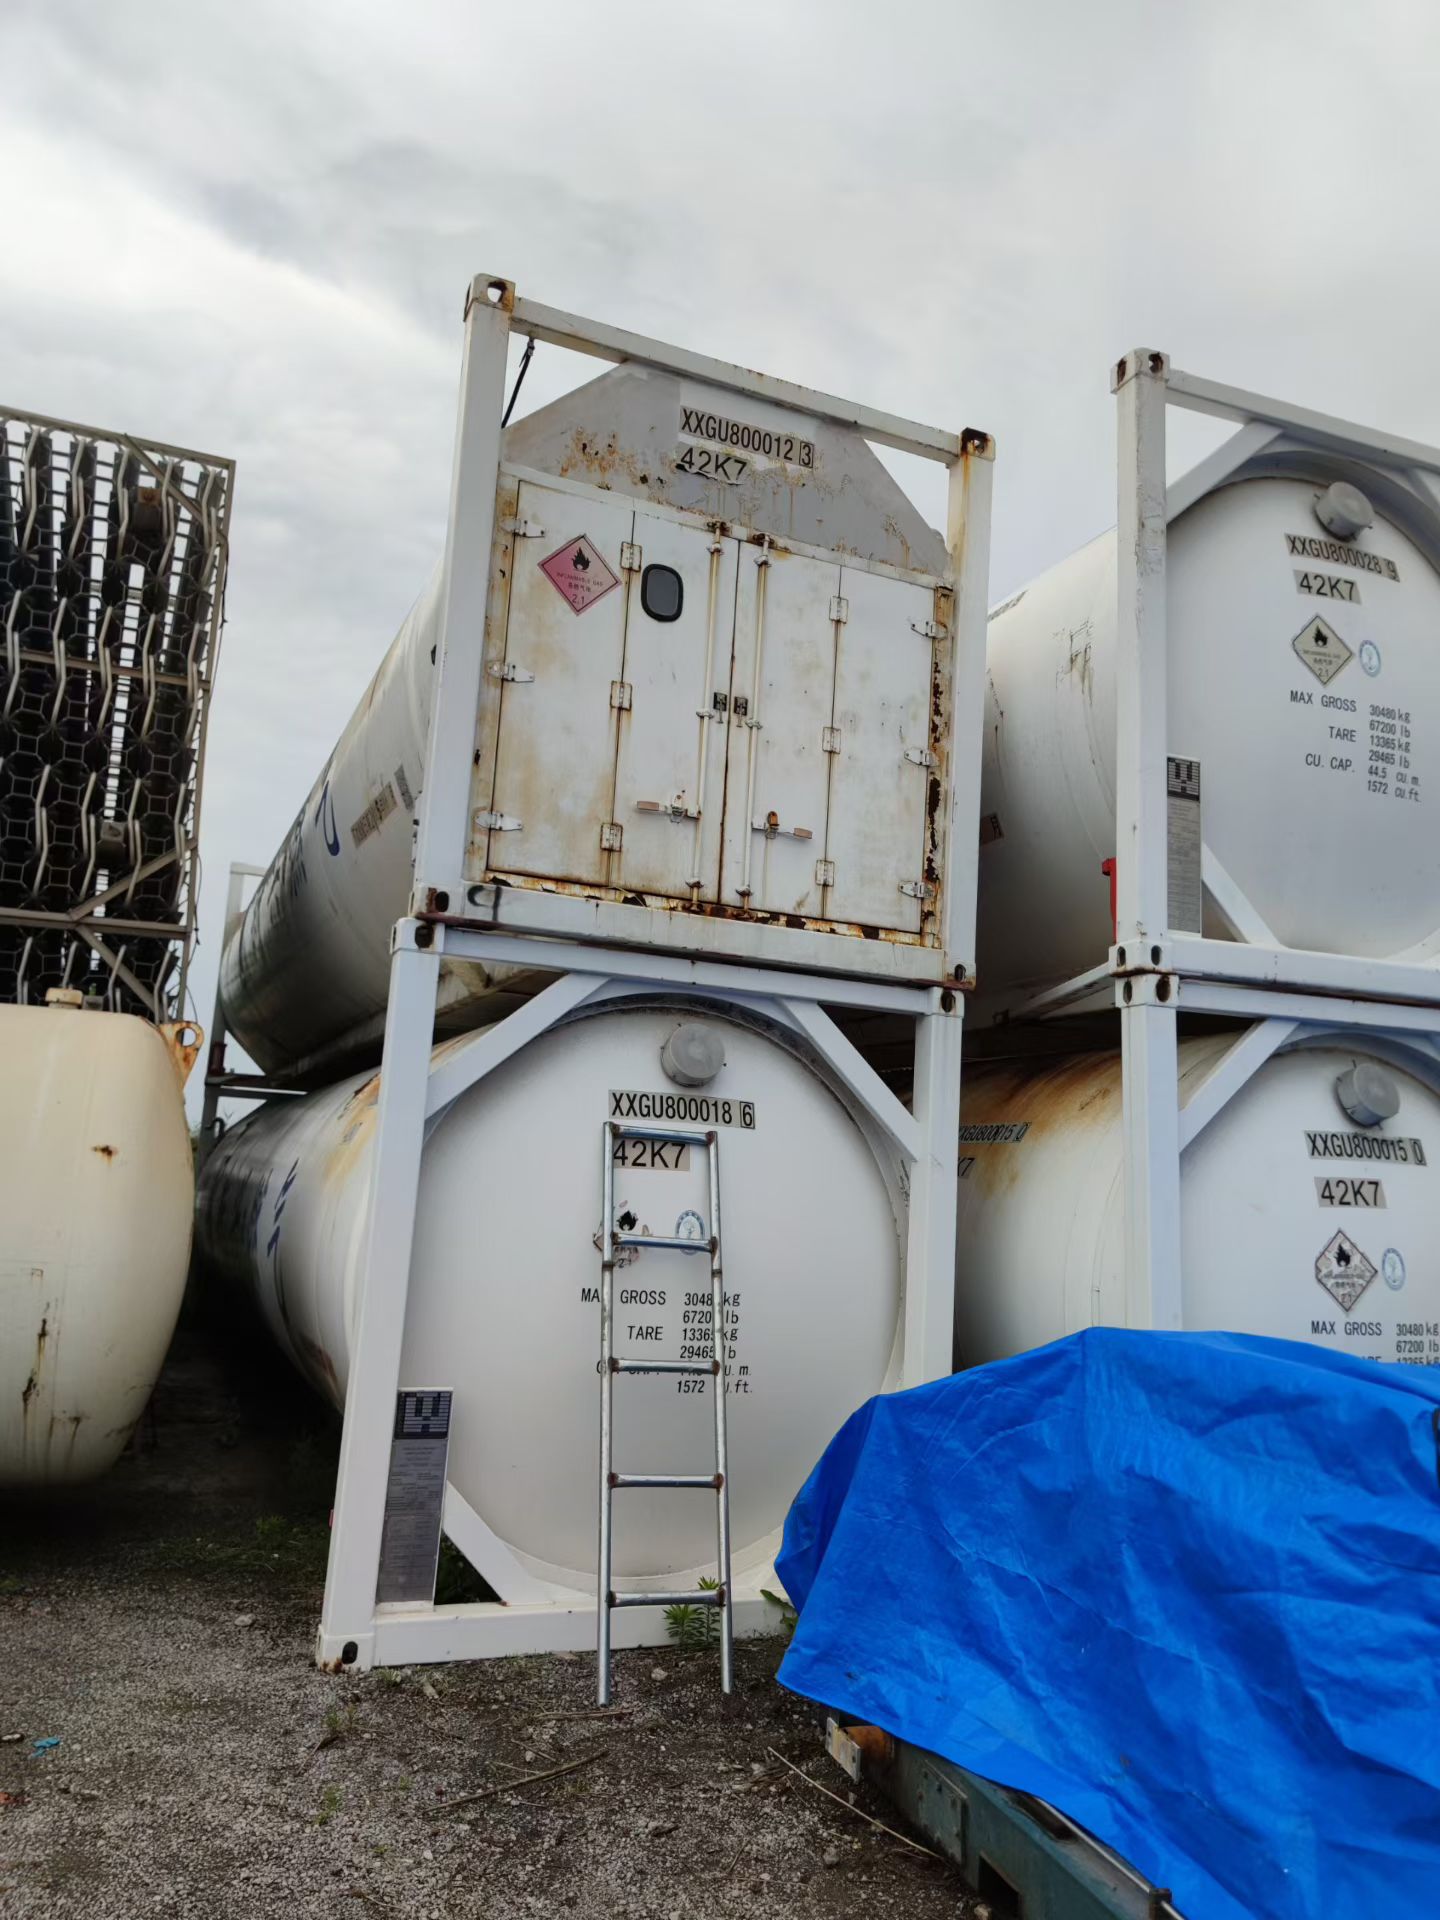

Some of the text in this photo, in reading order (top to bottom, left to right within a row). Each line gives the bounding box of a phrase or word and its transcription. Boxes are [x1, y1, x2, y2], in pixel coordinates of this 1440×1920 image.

[682, 408, 812, 466] XXGU800012 3
[680, 447, 747, 481] 42K7
[1288, 535, 1382, 574] XXGU800028
[1299, 573, 1355, 600] 42K7
[1290, 690, 1314, 705] MAX
[1321, 694, 1357, 712] GROSS
[1369, 704, 1396, 720] 30480
[1328, 726, 1357, 742] TARE
[1369, 720, 1396, 735] 67200
[1305, 753, 1324, 768] CU.
[1330, 757, 1355, 773] CAP.
[1367, 765, 1387, 779] 44.5
[1367, 780, 1389, 795] 1572
[612, 1092, 753, 1127] XXGU800018 6
[613, 1140, 686, 1169] 42K7
[1307, 1132, 1408, 1162] XXGU800015
[1321, 1179, 1379, 1206] 42K7
[620, 1289, 666, 1305] GROSS
[684, 1293, 713, 1306] 3048
[723, 1292, 740, 1306] kg
[683, 1310, 739, 1324] 6720 lb
[1311, 1320, 1439, 1337] MAX GROSS 30480 kg
[627, 1326, 664, 1341] TARE
[1396, 1339, 1439, 1353] 67200 lb
[677, 1380, 705, 1394] 1572
